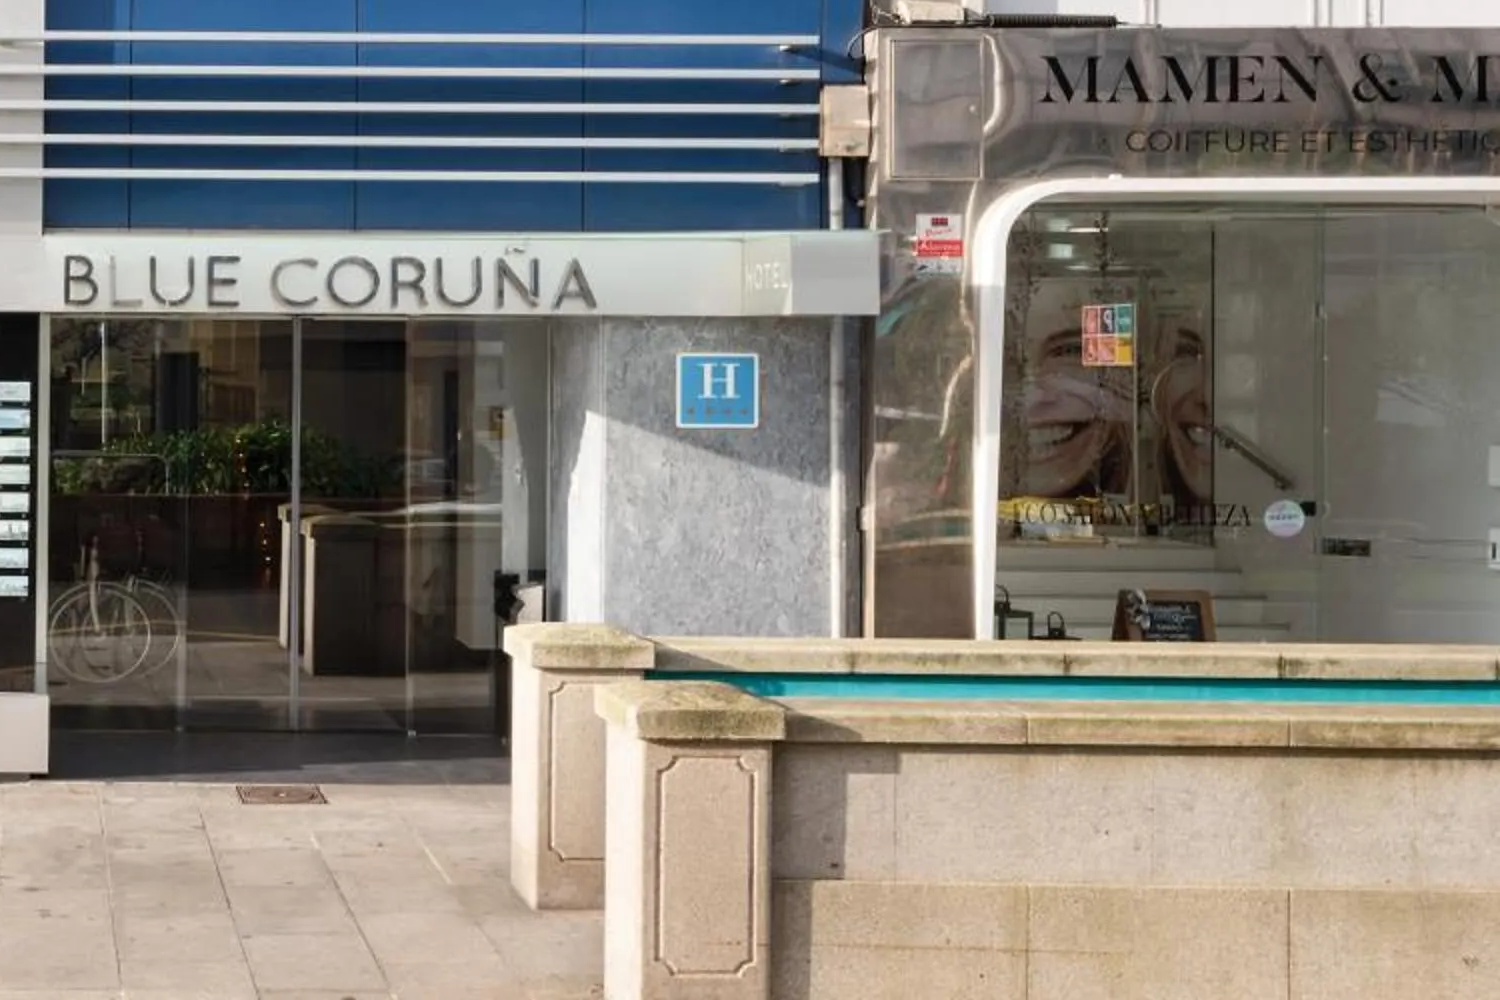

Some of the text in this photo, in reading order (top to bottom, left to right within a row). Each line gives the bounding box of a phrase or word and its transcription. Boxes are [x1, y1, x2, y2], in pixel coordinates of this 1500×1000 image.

[1039, 52, 1500, 103] MAMEN & M
[1125, 128, 1291, 154] COIFFURE
[1300, 128, 1339, 154] ET
[63, 245, 597, 311] BLUE CORUÑA
[696, 362, 742, 400] H
